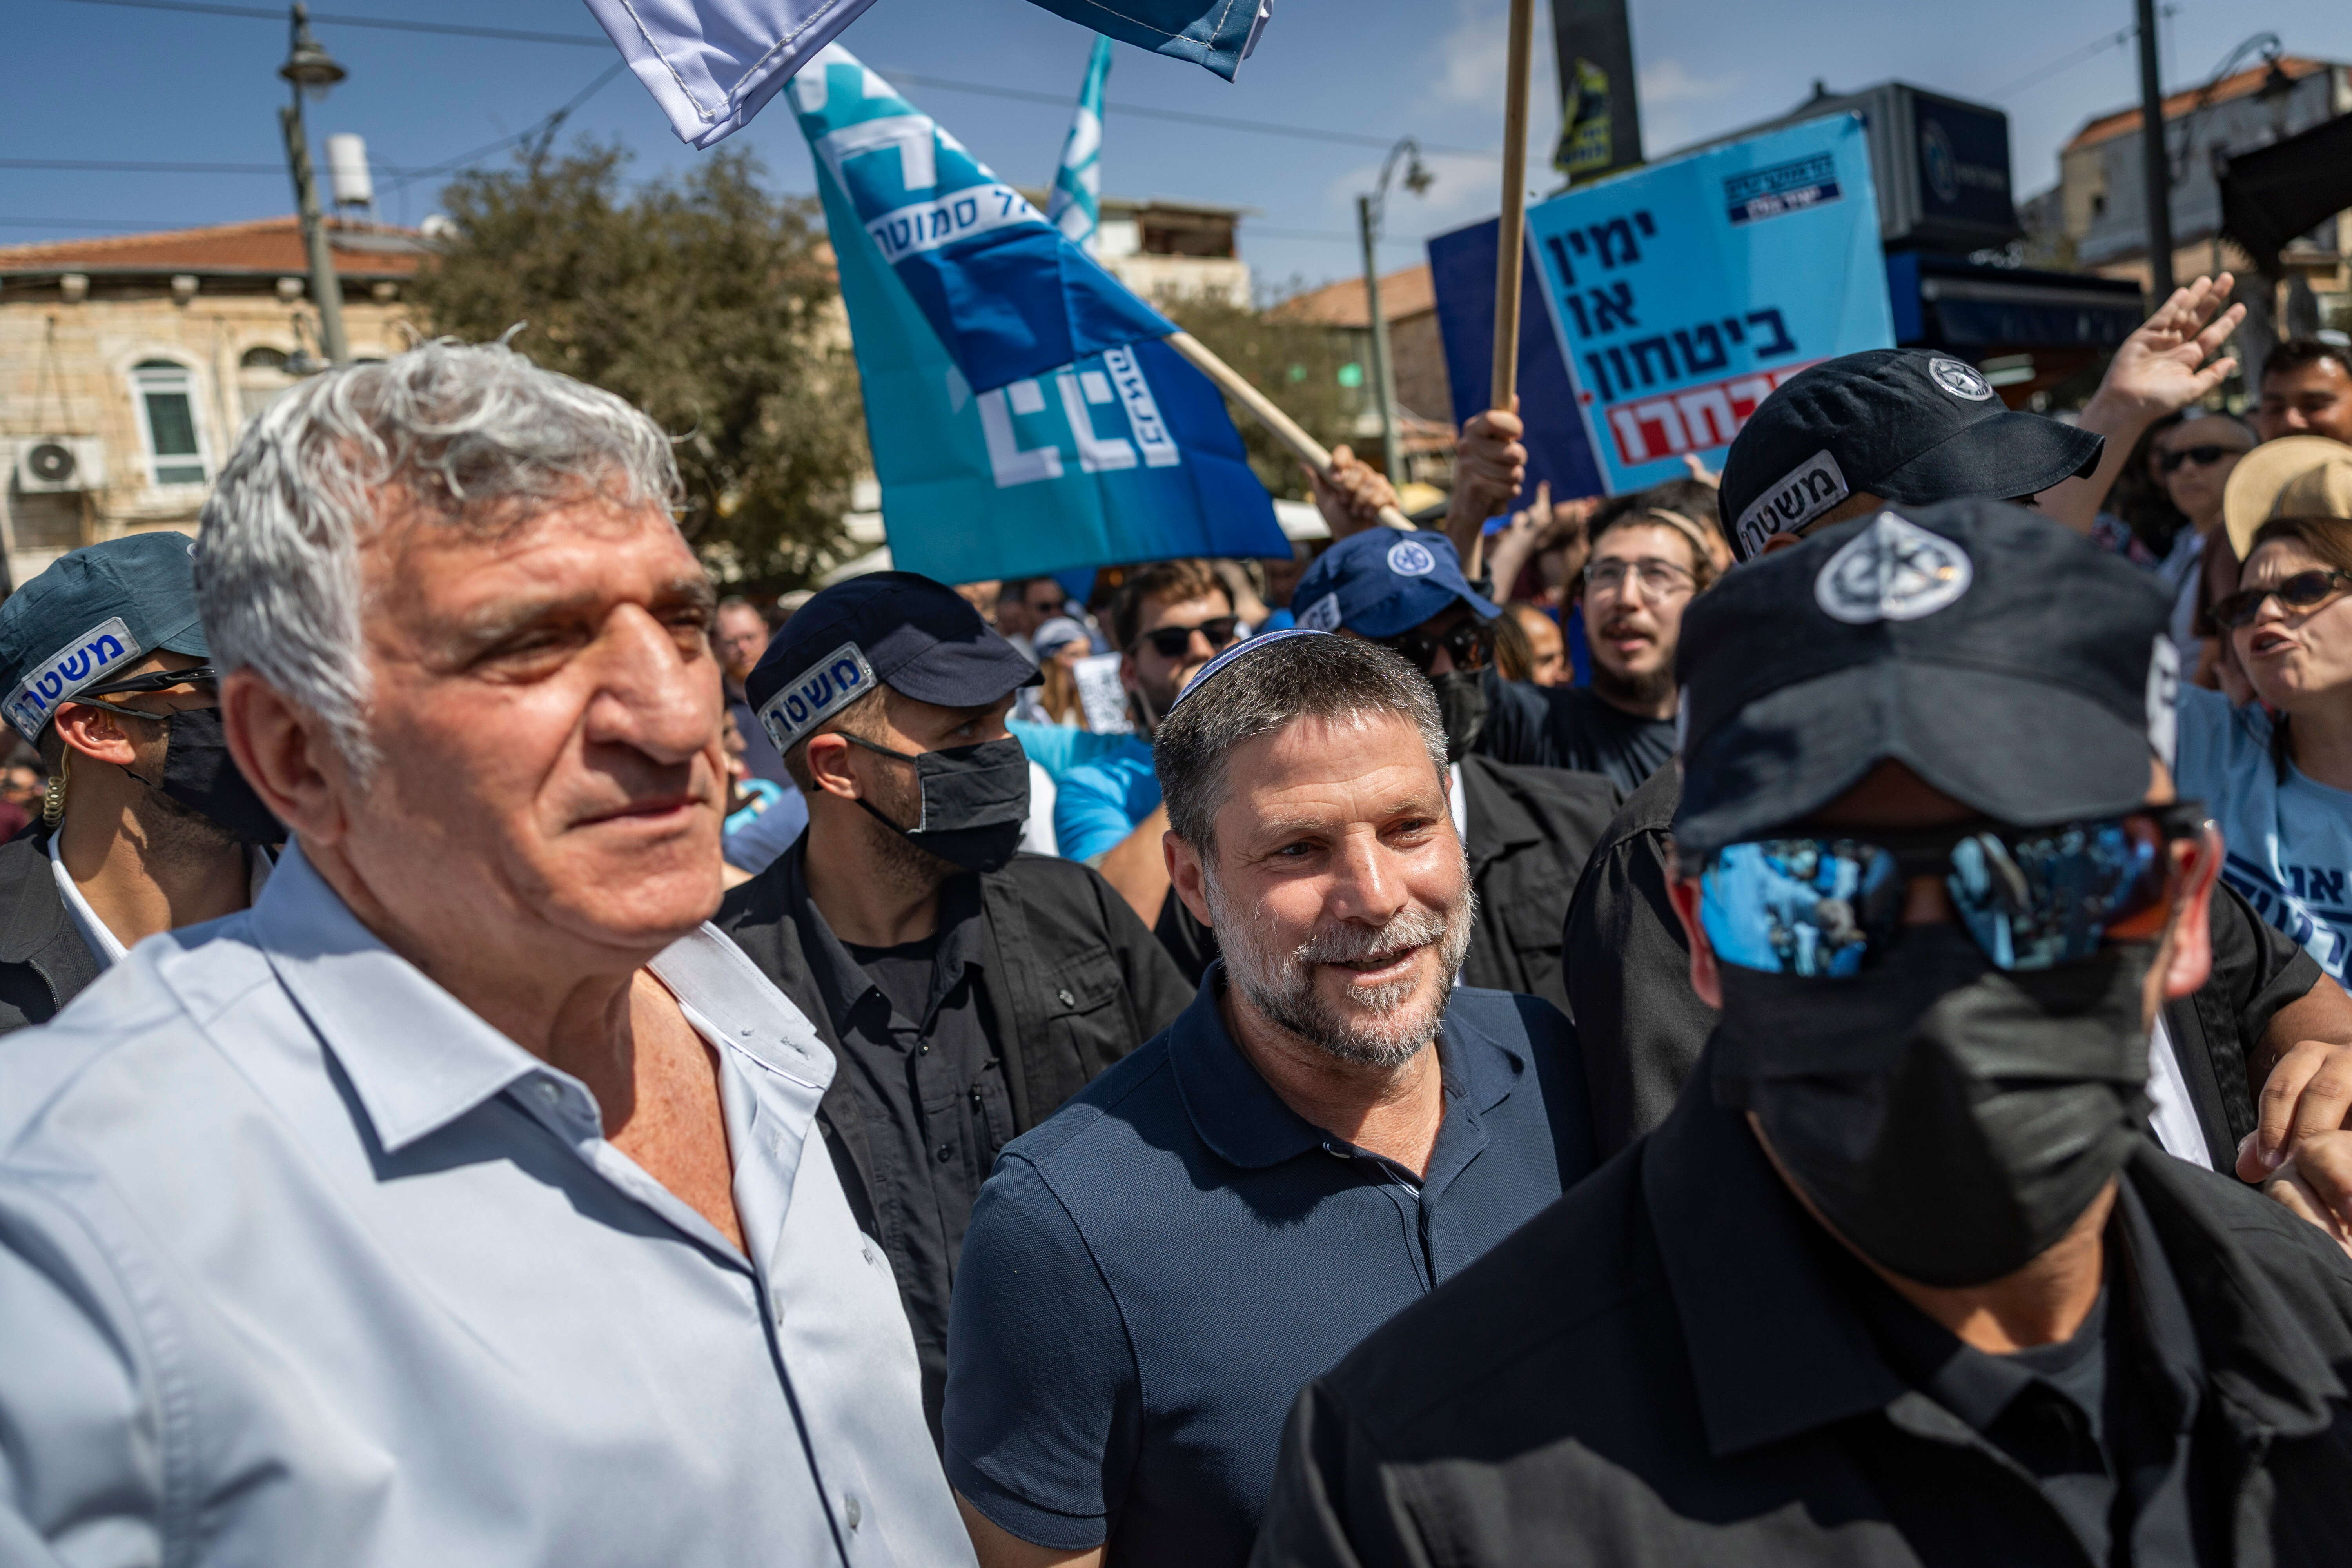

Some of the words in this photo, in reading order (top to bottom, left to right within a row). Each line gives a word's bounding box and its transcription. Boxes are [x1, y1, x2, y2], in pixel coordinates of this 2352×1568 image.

[873, 198, 976, 256] סמוטר
[1548, 212, 1655, 286] ימין
[1569, 282, 1638, 338] או
[1612, 367, 1805, 459] בחרו
